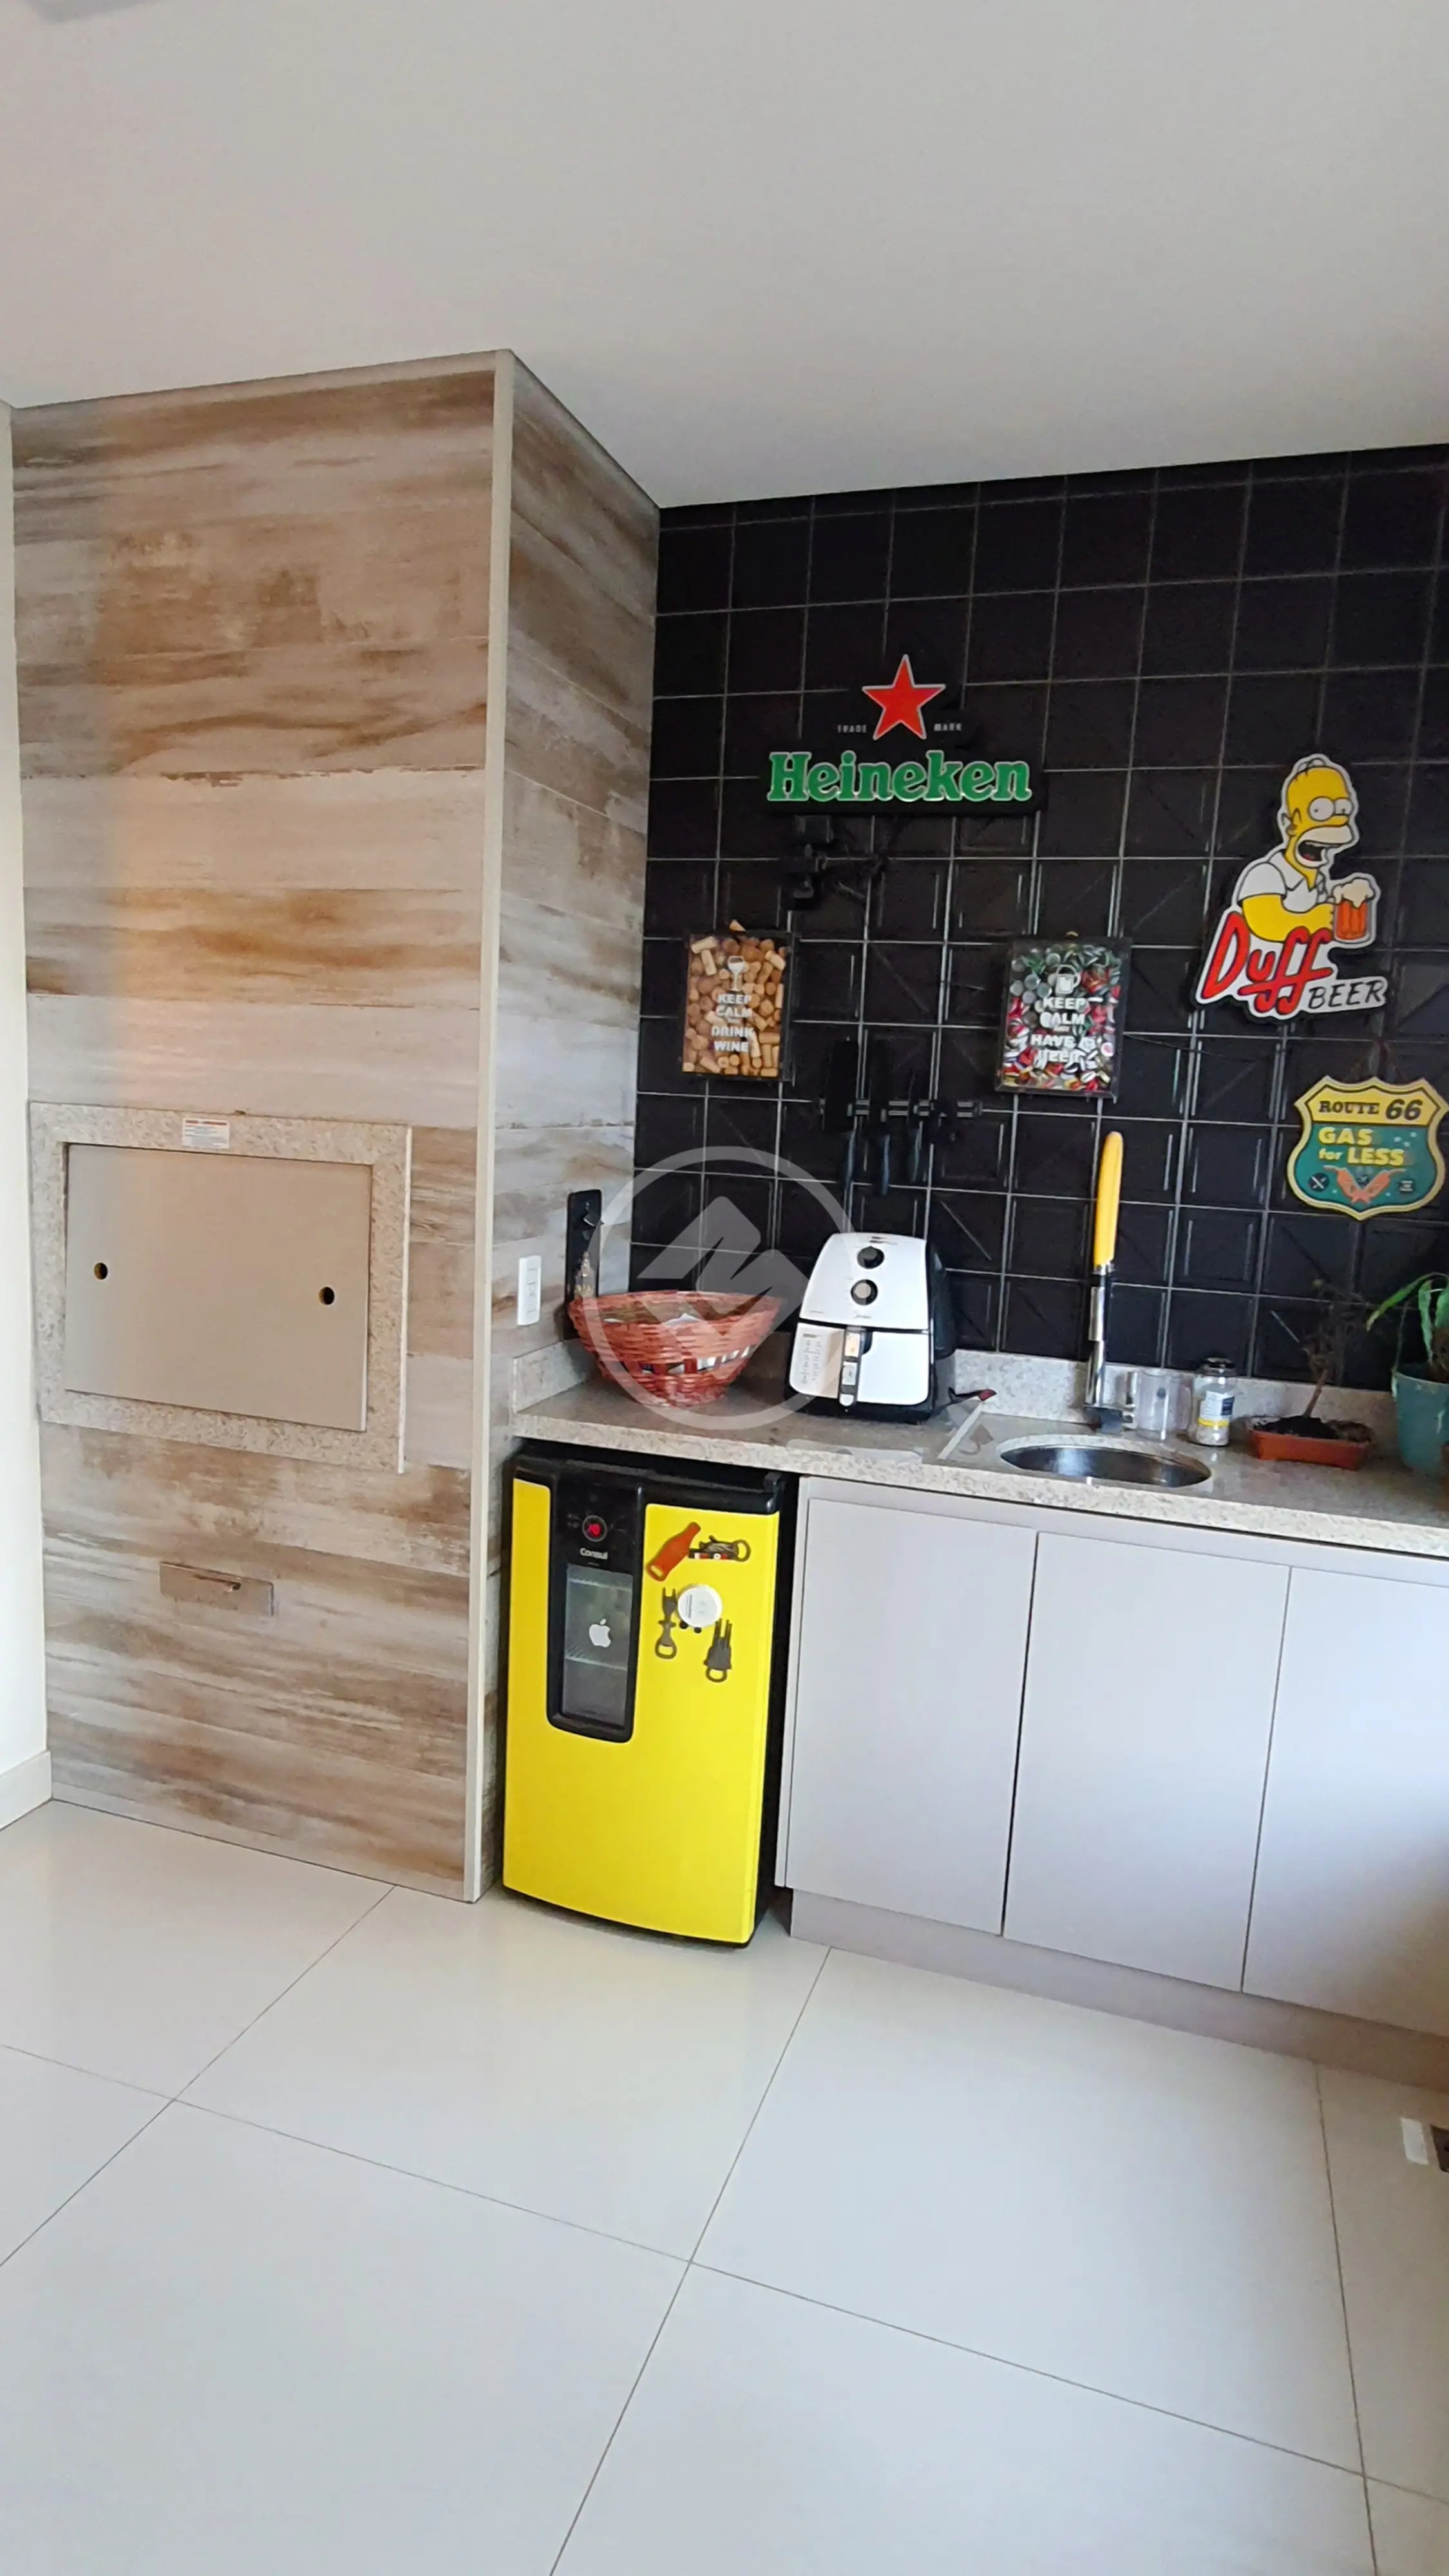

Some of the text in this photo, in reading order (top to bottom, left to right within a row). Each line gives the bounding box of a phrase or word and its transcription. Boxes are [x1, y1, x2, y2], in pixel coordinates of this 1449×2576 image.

[767, 750, 1032, 802] Heineken
[1201, 911, 1334, 1016] Duff
[718, 994, 752, 1004] KEEP
[1308, 980, 1384, 1009] BEER
[1043, 996, 1086, 1009] KEEP
[716, 1005, 753, 1018] CALM
[1040, 1012, 1085, 1026] CALM
[712, 1026, 754, 1037] DRINK
[714, 1041, 749, 1052] WINE
[1030, 1034, 1076, 1048] HAVE
[1319, 1099, 1423, 1121] ROUTE 66
[1318, 1127, 1373, 1145] GAS
[1319, 1147, 1405, 1166] for LESS
